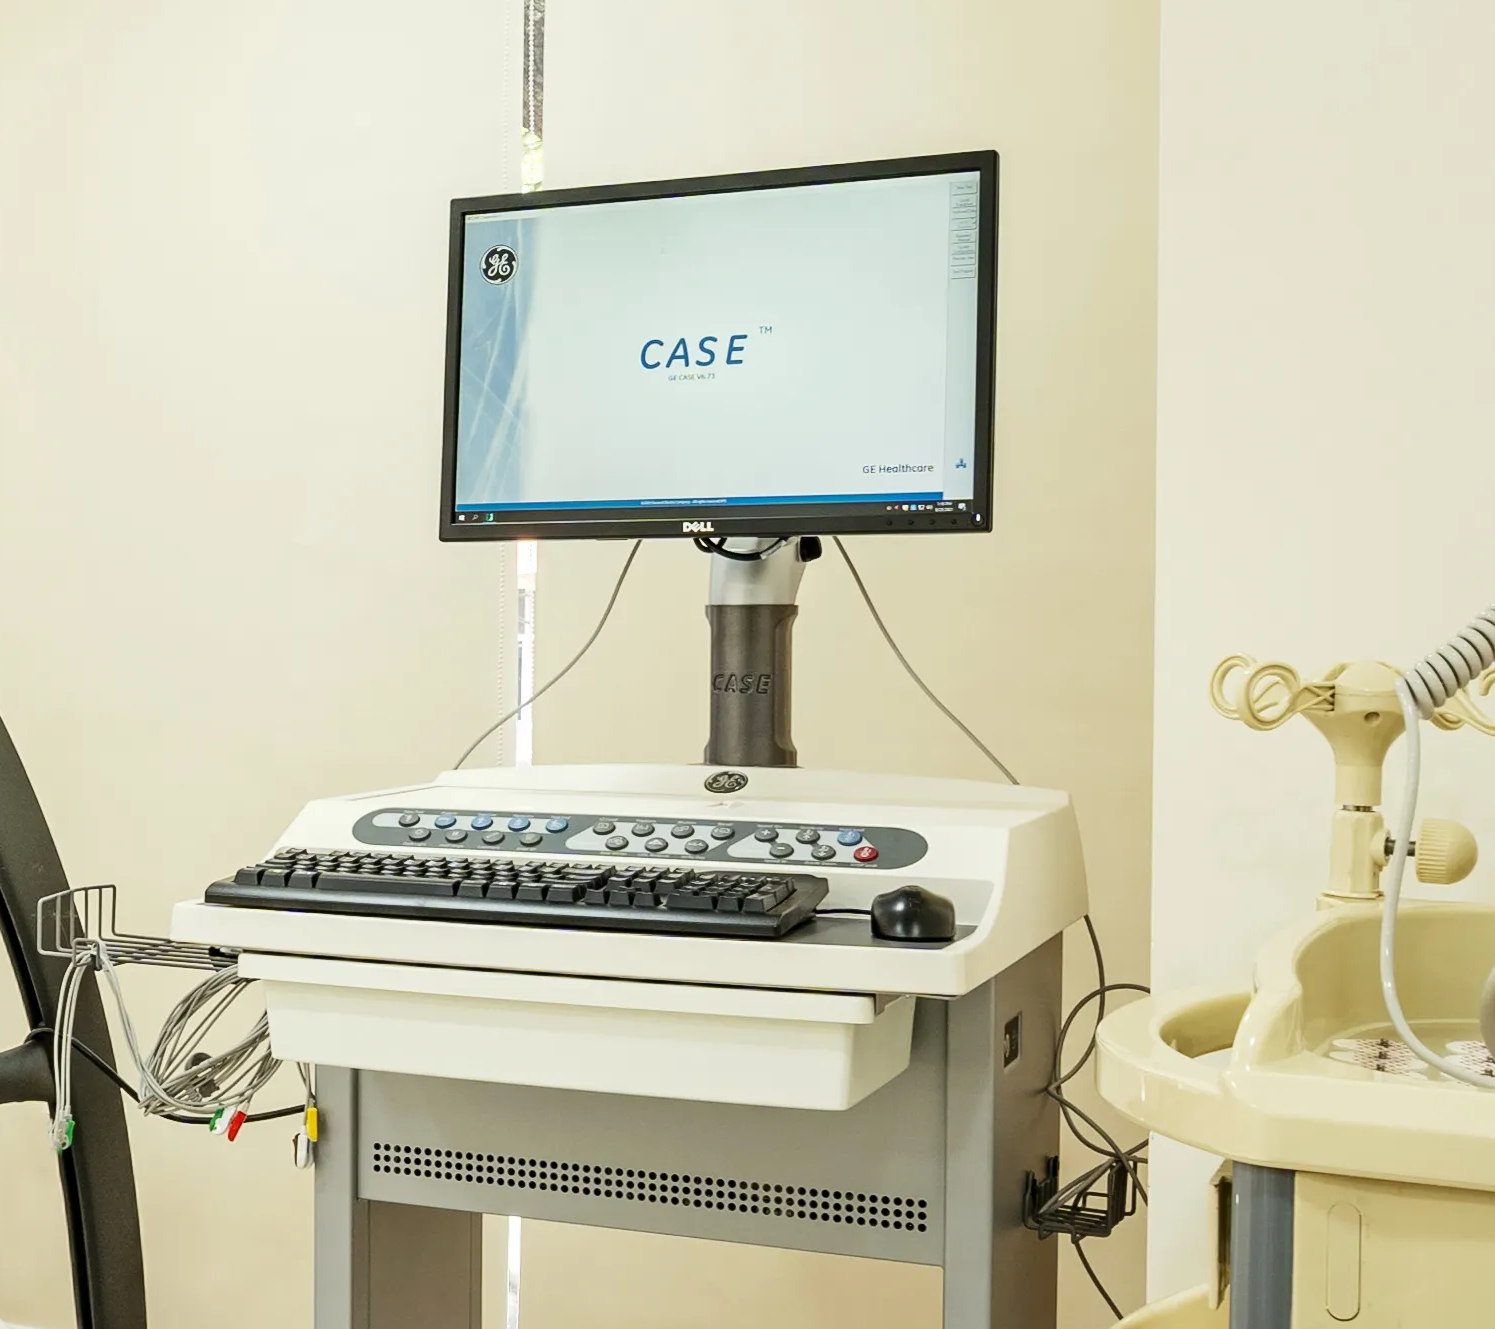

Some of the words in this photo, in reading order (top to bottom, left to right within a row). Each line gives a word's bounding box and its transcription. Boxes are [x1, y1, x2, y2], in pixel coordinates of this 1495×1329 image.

[640, 334, 748, 369] CASE
[862, 465, 876, 474] GE
[878, 462, 934, 474] Healthcare
[682, 521, 715, 533] DELL
[712, 673, 771, 695] CASE
